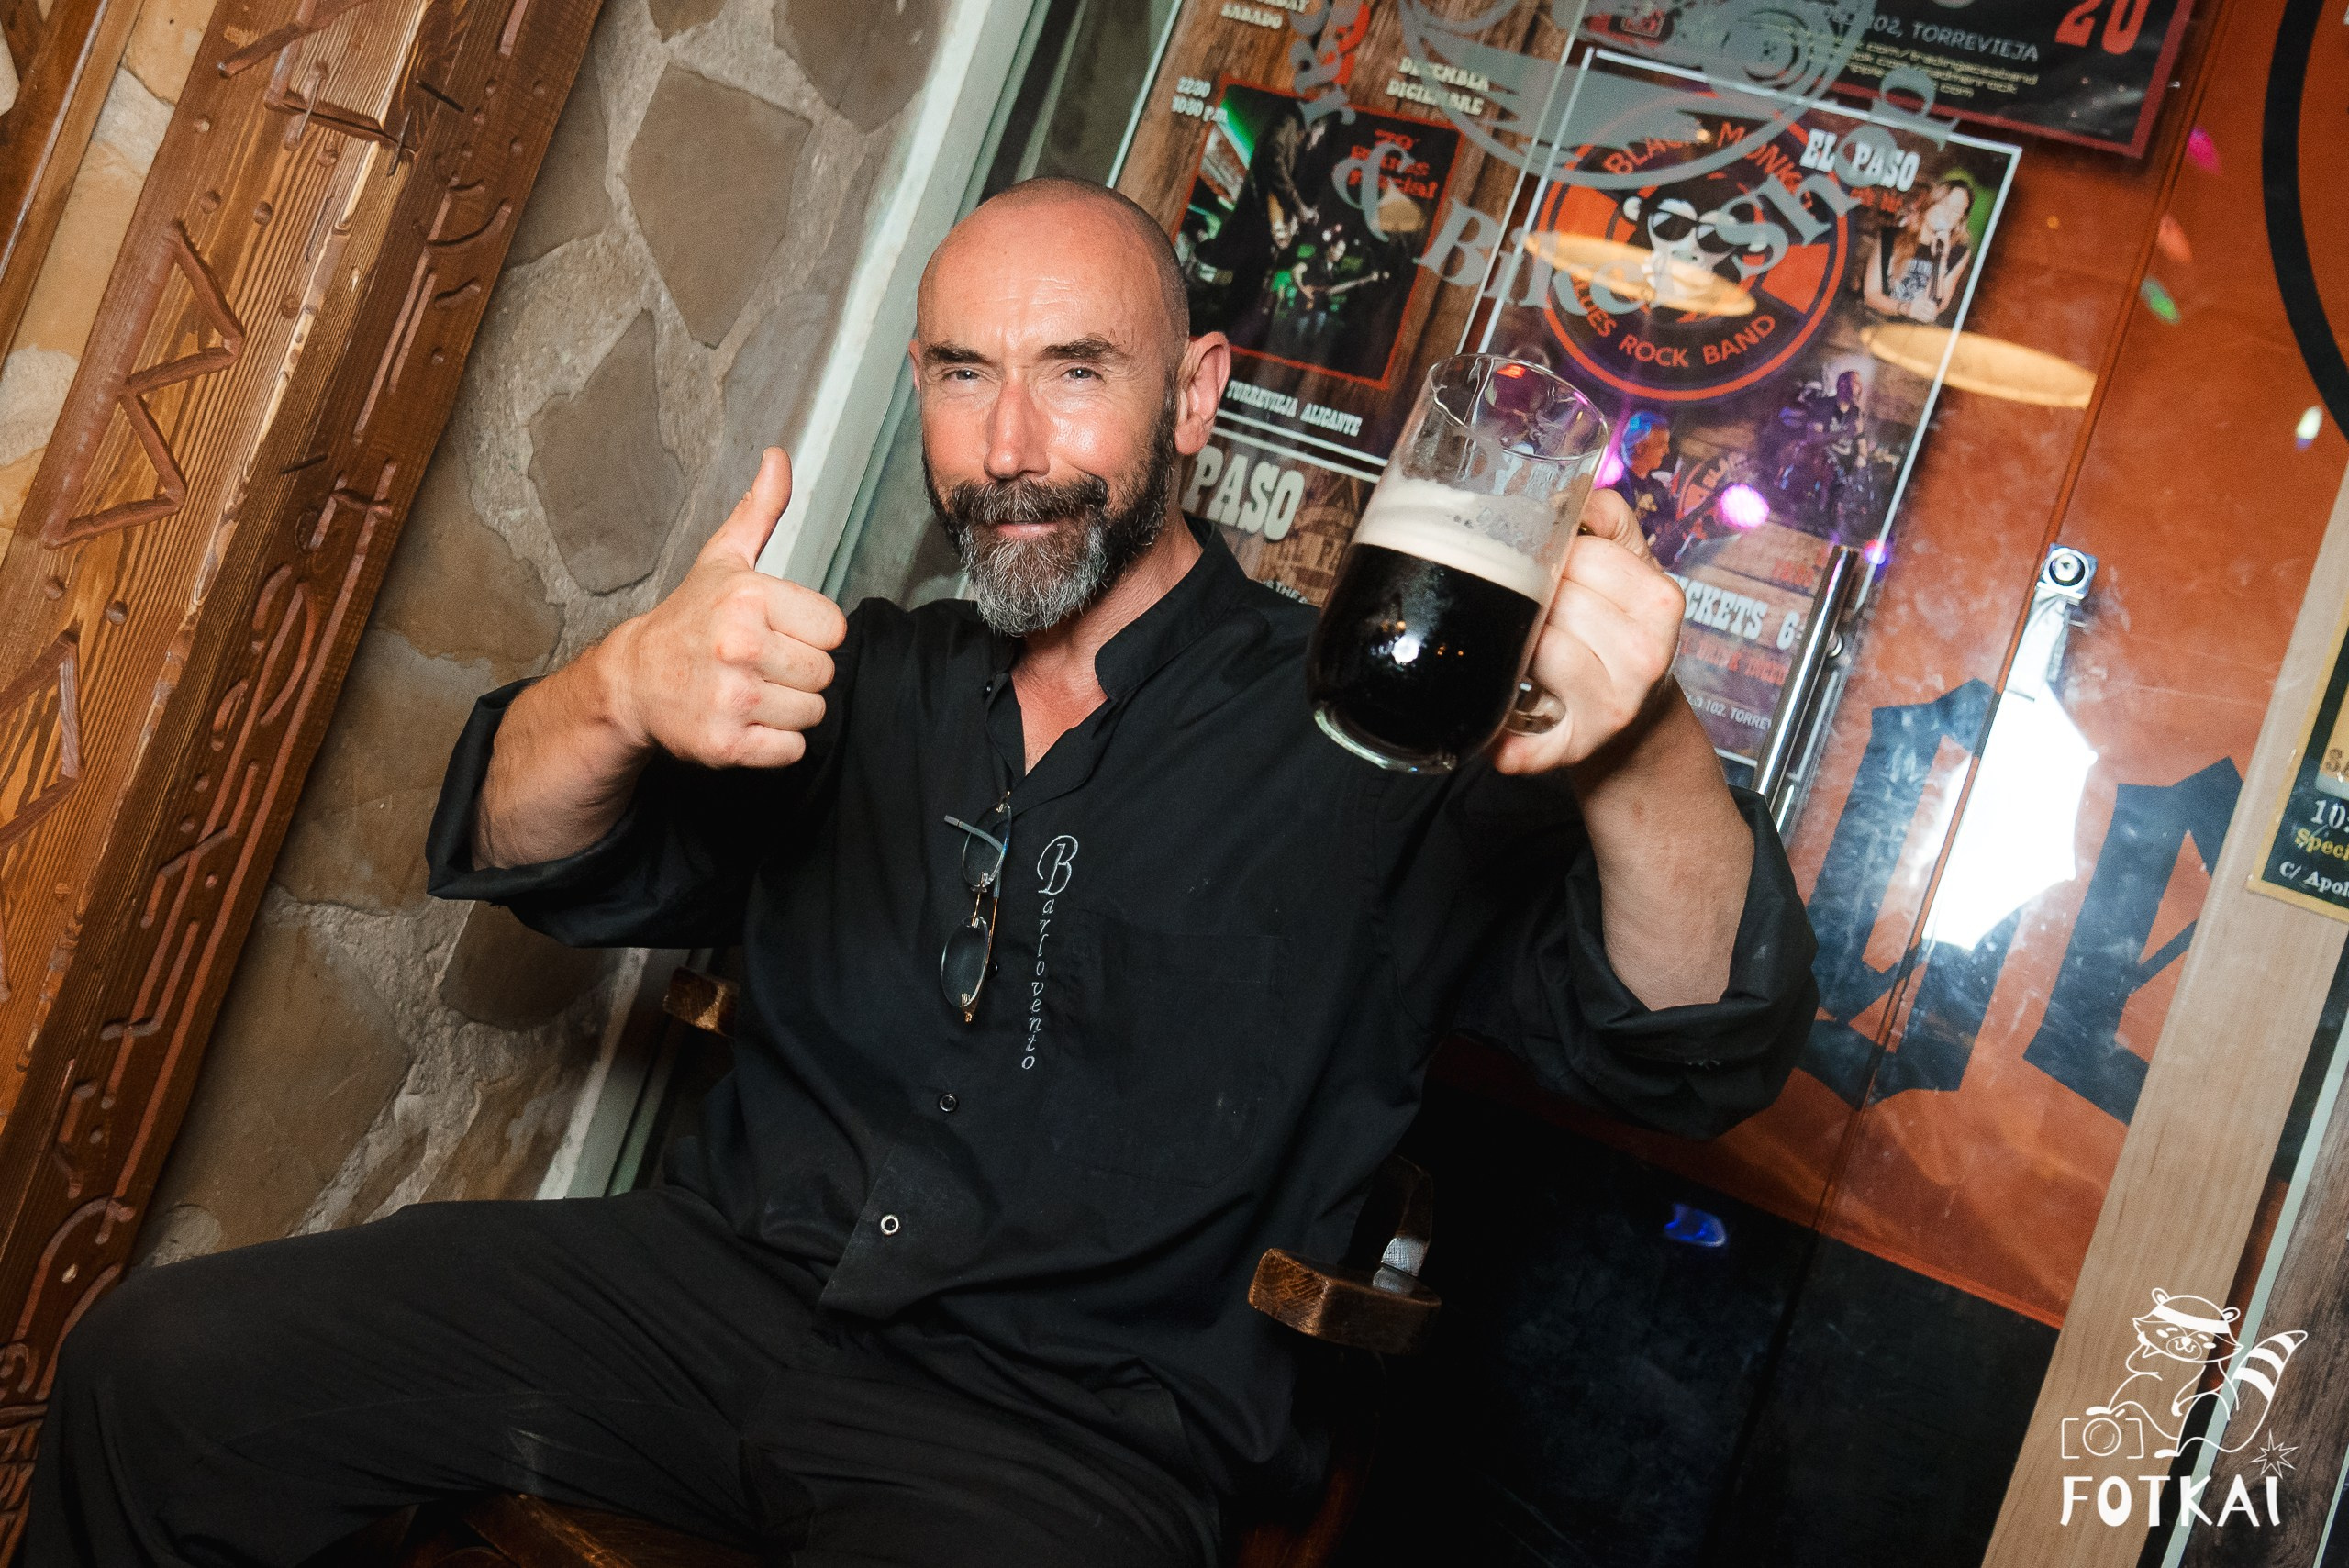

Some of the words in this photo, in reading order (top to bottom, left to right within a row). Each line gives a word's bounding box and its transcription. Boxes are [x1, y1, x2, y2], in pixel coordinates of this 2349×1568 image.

[1912, 21, 2040, 63] TORREVIEJA
[1800, 128, 1838, 173] EL
[1852, 142, 1920, 193] PASO
[1618, 332, 1689, 367] ROCK
[1701, 314, 1776, 366] BAND
[1300, 403, 1363, 437] ALICANTE
[1181, 444, 1305, 541] PASO
[1675, 574, 1768, 640] CKETS
